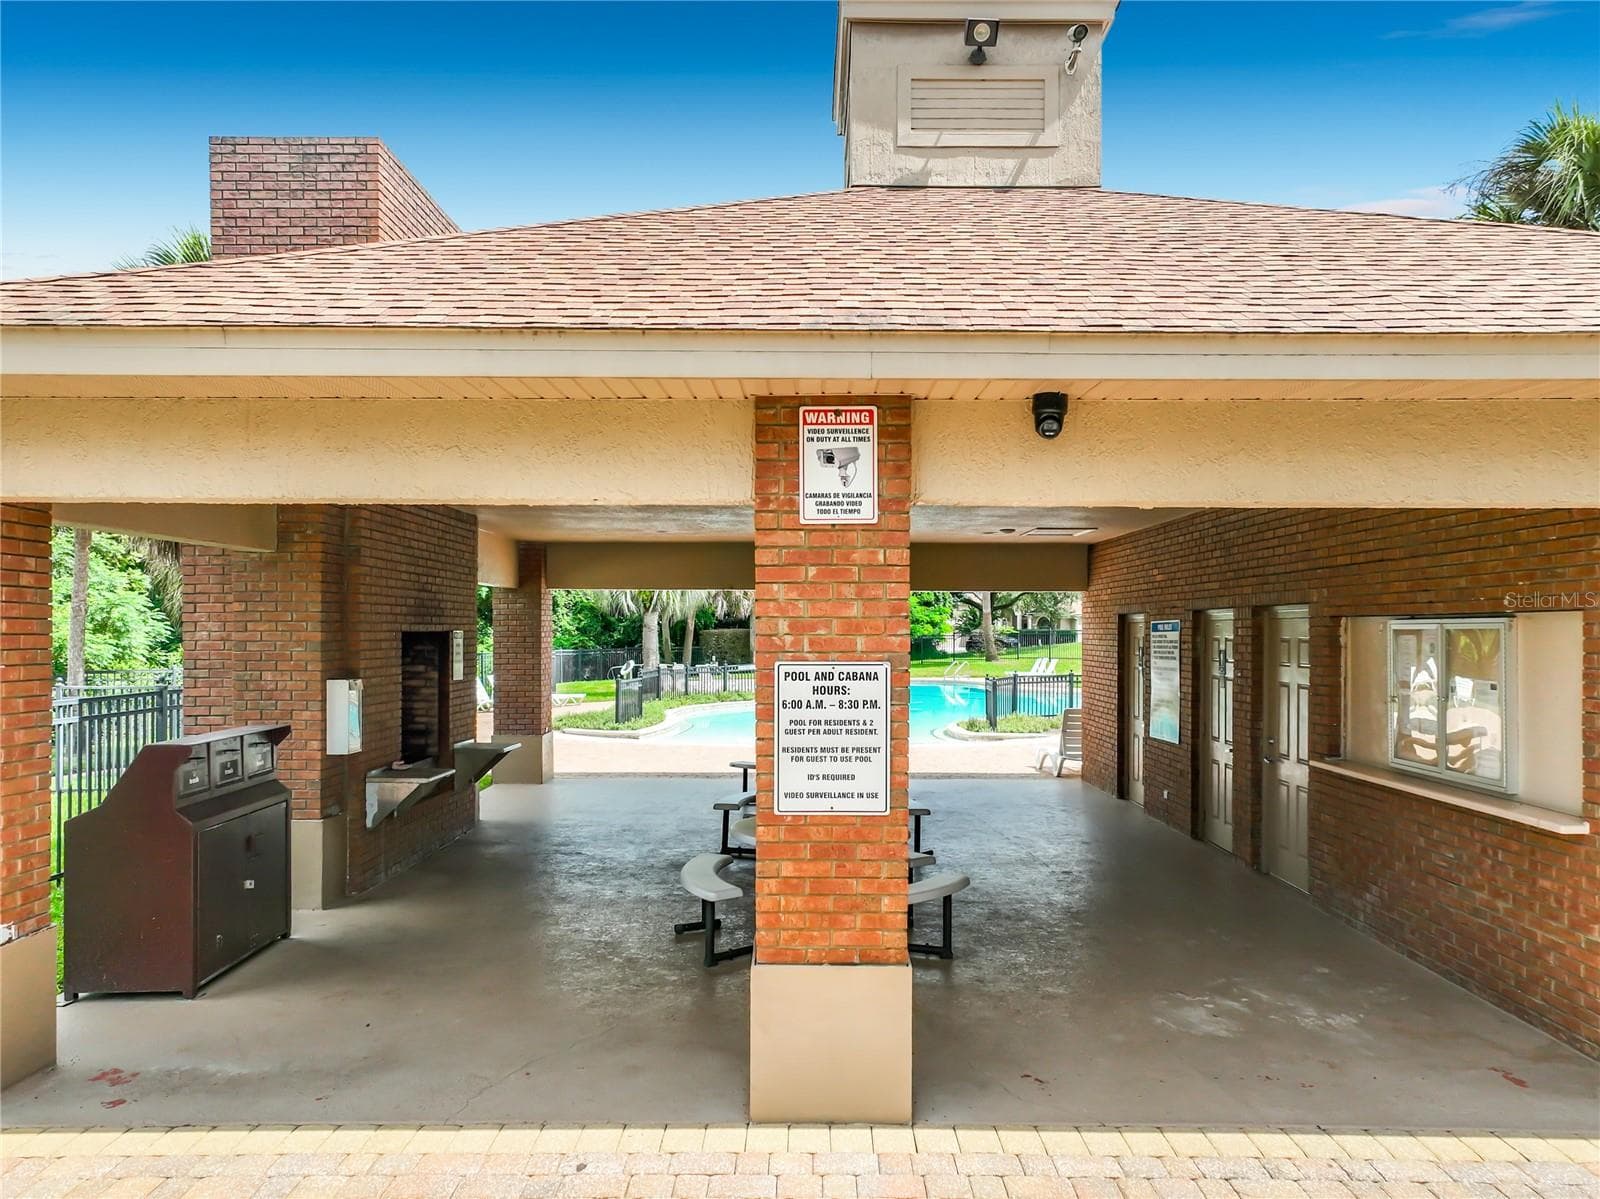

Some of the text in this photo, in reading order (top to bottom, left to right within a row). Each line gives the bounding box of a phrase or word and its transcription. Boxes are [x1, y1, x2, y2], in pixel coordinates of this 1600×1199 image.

[804, 412, 869, 423] WARNING
[784, 672, 879, 681] POOL AND CABANA
[812, 686, 850, 695] HOURS:
[782, 700, 803, 709] 6:00
[806, 700, 826, 709] A.M.
[838, 700, 859, 709] 8:30
[862, 700, 881, 709] P.M.
